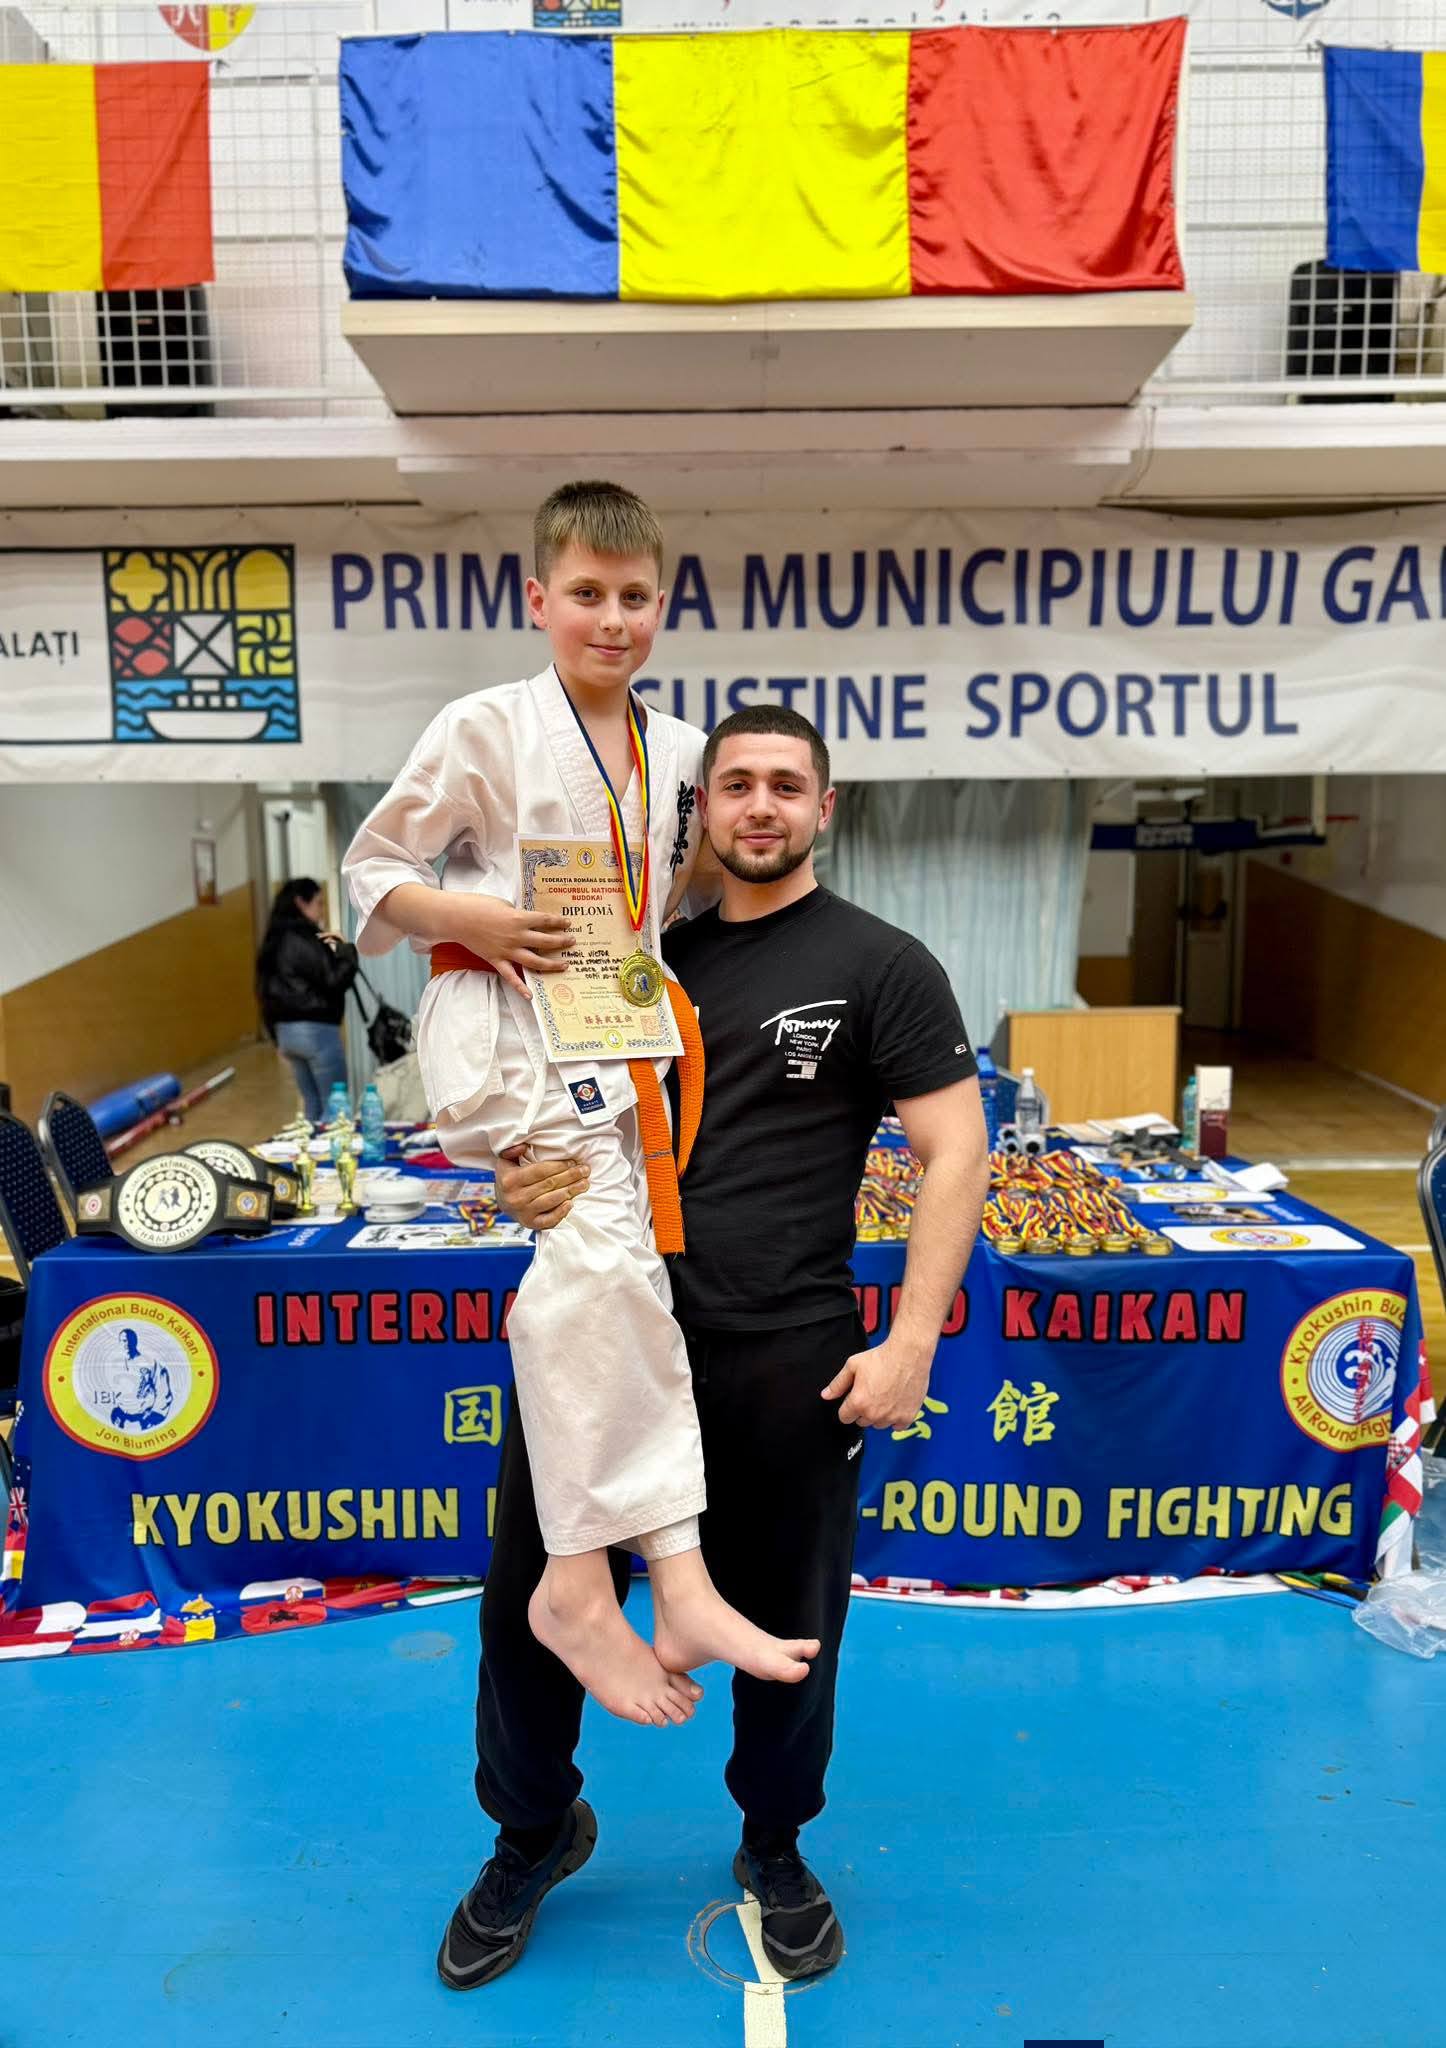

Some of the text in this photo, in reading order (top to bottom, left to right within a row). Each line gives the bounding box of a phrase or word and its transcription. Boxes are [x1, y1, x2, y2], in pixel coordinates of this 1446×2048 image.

[331, 553, 717, 631] PRIMA
[742, 547, 1300, 631] MUNICIPIULUI
[966, 672, 1299, 738] SPORTUL
[562, 904, 614, 916] DIPLOMĂ
[760, 1000, 847, 1051] Tommy
[793, 1032, 817, 1041] LONDON
[804, 1040, 820, 1048] YORK
[797, 1053, 822, 1061] ANGELES
[134, 1226, 195, 1245] CHAMPION
[61, 1303, 199, 1357] International Budo Kaikan
[1004, 1288, 1245, 1342] KAIKAN
[1288, 1297, 1372, 1365] Kyokushin
[94, 1391, 122, 1405] IBK
[444, 1385, 502, 1446] 国
[1293, 1394, 1313, 1416] All
[1311, 1411, 1357, 1442] Round
[95, 1427, 177, 1449] Jon Bluming
[131, 1487, 459, 1546] KYOKUSHIN
[1107, 1484, 1352, 1539] FIGHTING
